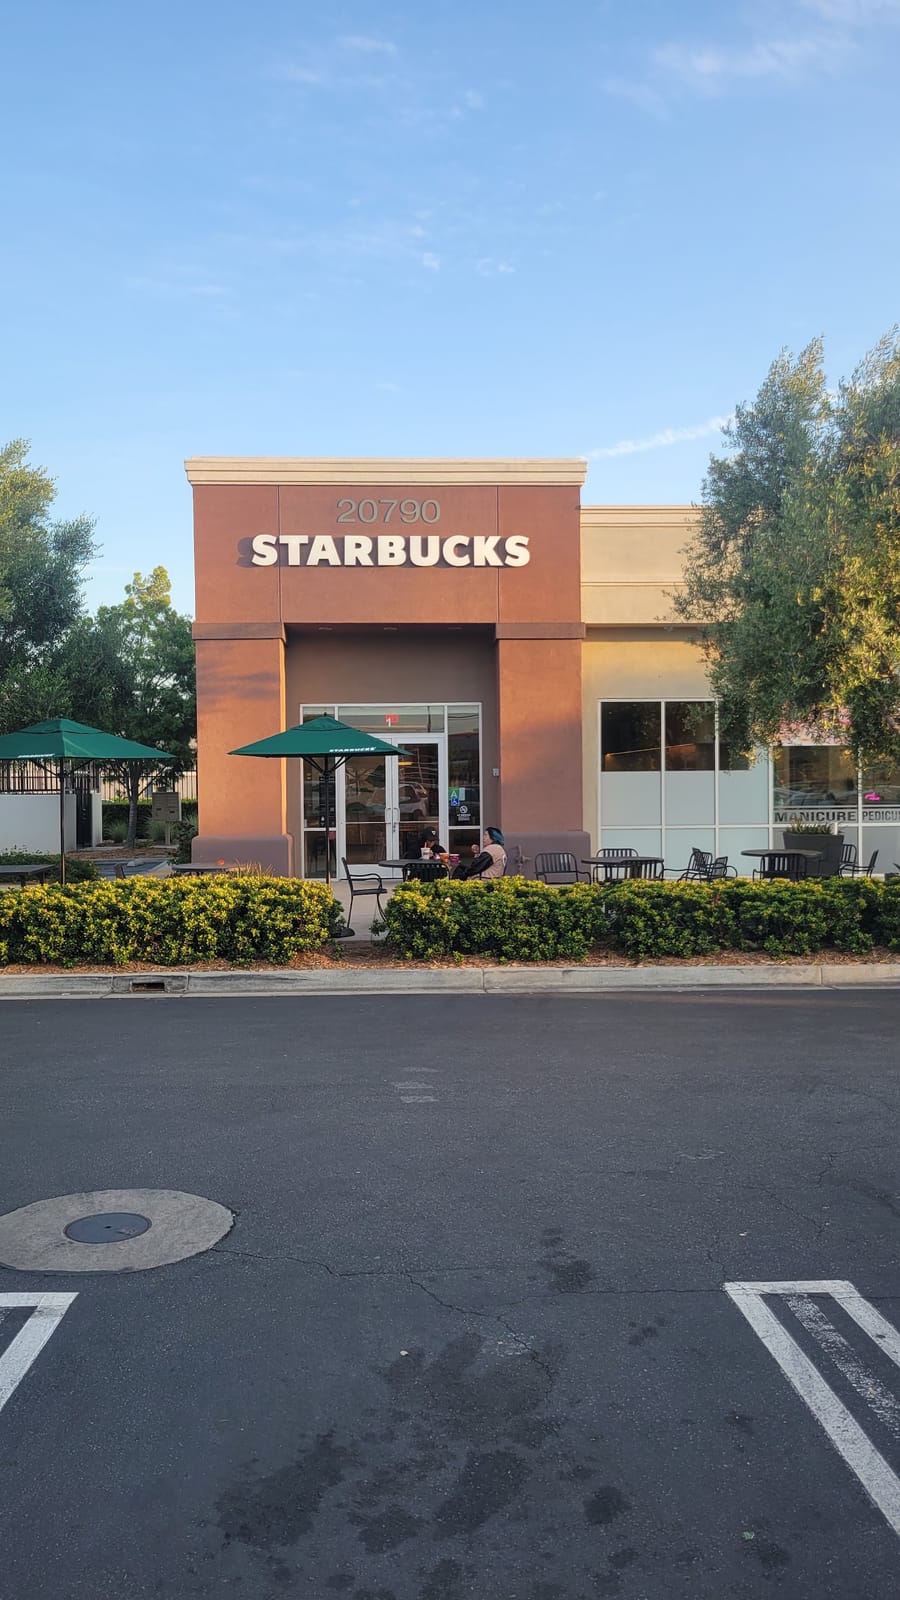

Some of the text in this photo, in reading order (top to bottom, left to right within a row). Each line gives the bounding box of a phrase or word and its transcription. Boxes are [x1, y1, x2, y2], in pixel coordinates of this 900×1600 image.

[336, 499, 441, 524] 20790
[251, 534, 531, 567] STARBUCKS
[774, 811, 857, 822] MANICURE
[862, 810, 900, 821] PEDICU
